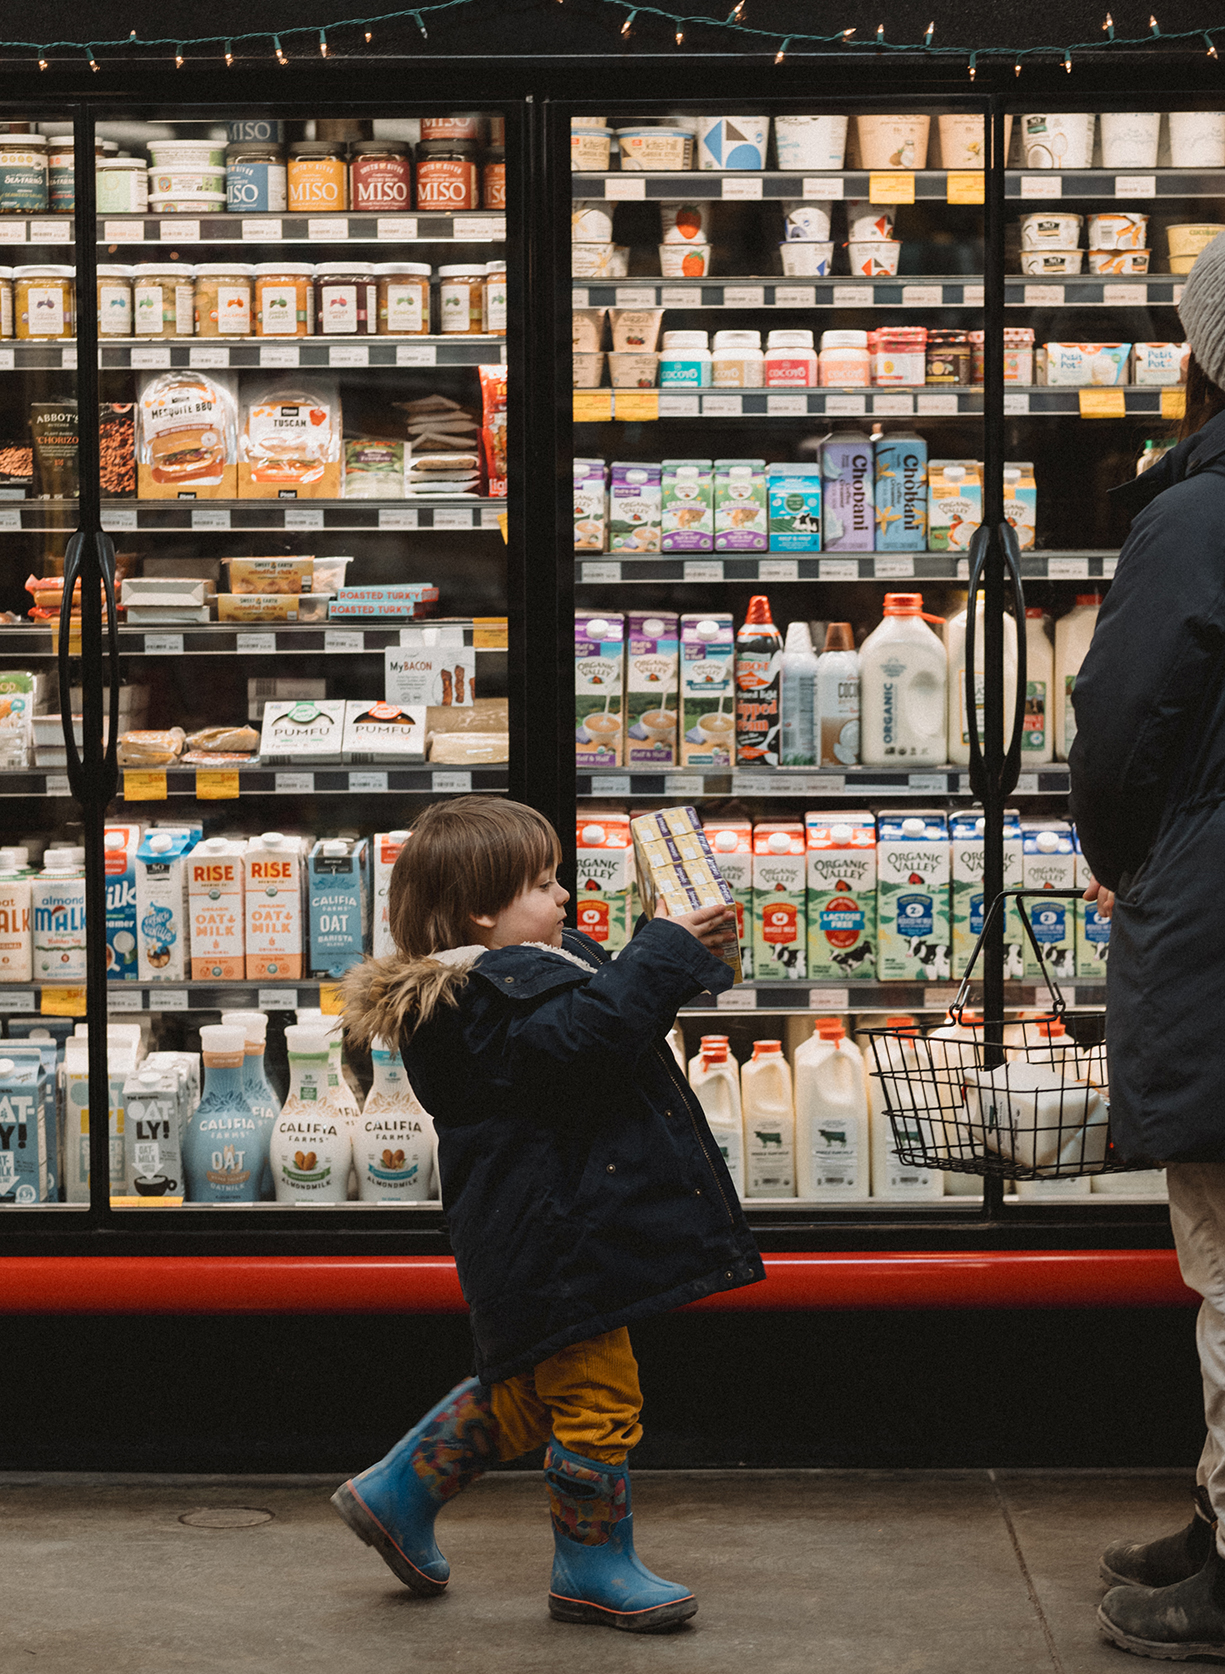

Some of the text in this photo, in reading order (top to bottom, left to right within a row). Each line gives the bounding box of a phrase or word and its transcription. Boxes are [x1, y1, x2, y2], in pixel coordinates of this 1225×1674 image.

[290, 183, 338, 201] MISO
[358, 182, 407, 201] MISO
[418, 182, 466, 200] MISO
[1061, 353, 1082, 361] Petit
[1148, 350, 1172, 359] Petit
[1061, 360, 1076, 369] Pot
[1148, 359, 1165, 368] Pot
[152, 401, 212, 420] MESQUITE BBQ
[851, 454, 868, 531] Chobani
[903, 454, 920, 531] Chobani
[938, 502, 973, 510] ORGANIC
[340, 591, 420, 600] ROASTED TURK'Y
[331, 605, 412, 614] ROASTED TURK'Y
[390, 661, 432, 672] MyBACON
[577, 661, 616, 670] ORGANIC
[634, 660, 671, 668] ORGANIC
[581, 669, 611, 677] VALLEY
[884, 683, 893, 744] ORGANIC
[274, 728, 330, 736] PUMFU
[356, 726, 412, 734] PUMFU
[887, 852, 943, 865] ORGANIC
[577, 858, 619, 871] RGANIC
[814, 860, 870, 871] ORGANIC
[893, 860, 938, 873] VALLEY
[194, 866, 234, 881] RISE
[251, 863, 292, 878] RISE
[760, 868, 799, 876] ORGANIC
[820, 870, 865, 880] VALLEY
[1028, 867, 1067, 877] ORGANIC
[765, 874, 796, 882] VALLEY
[1034, 874, 1064, 882] VALLEY
[42, 896, 84, 905] almond
[106, 881, 136, 910] ilk
[312, 896, 357, 907] CALIFIA
[195, 915, 224, 924] OAT
[252, 911, 281, 921] OAT
[823, 913, 861, 921] LACTOSE
[252, 923, 291, 933] MILK
[320, 915, 349, 932] OAT
[196, 926, 234, 936] MILK
[318, 935, 353, 943] BARISTA
[199, 1119, 255, 1131] CALIFIA
[280, 1123, 337, 1135] CALIFIA
[365, 1121, 422, 1133] CALIFIA
[137, 1121, 169, 1140] LY!
[212, 1151, 245, 1170] OAT
[281, 1178, 331, 1190] ALMONDMILK
[367, 1176, 418, 1188] ALMONDMILK
